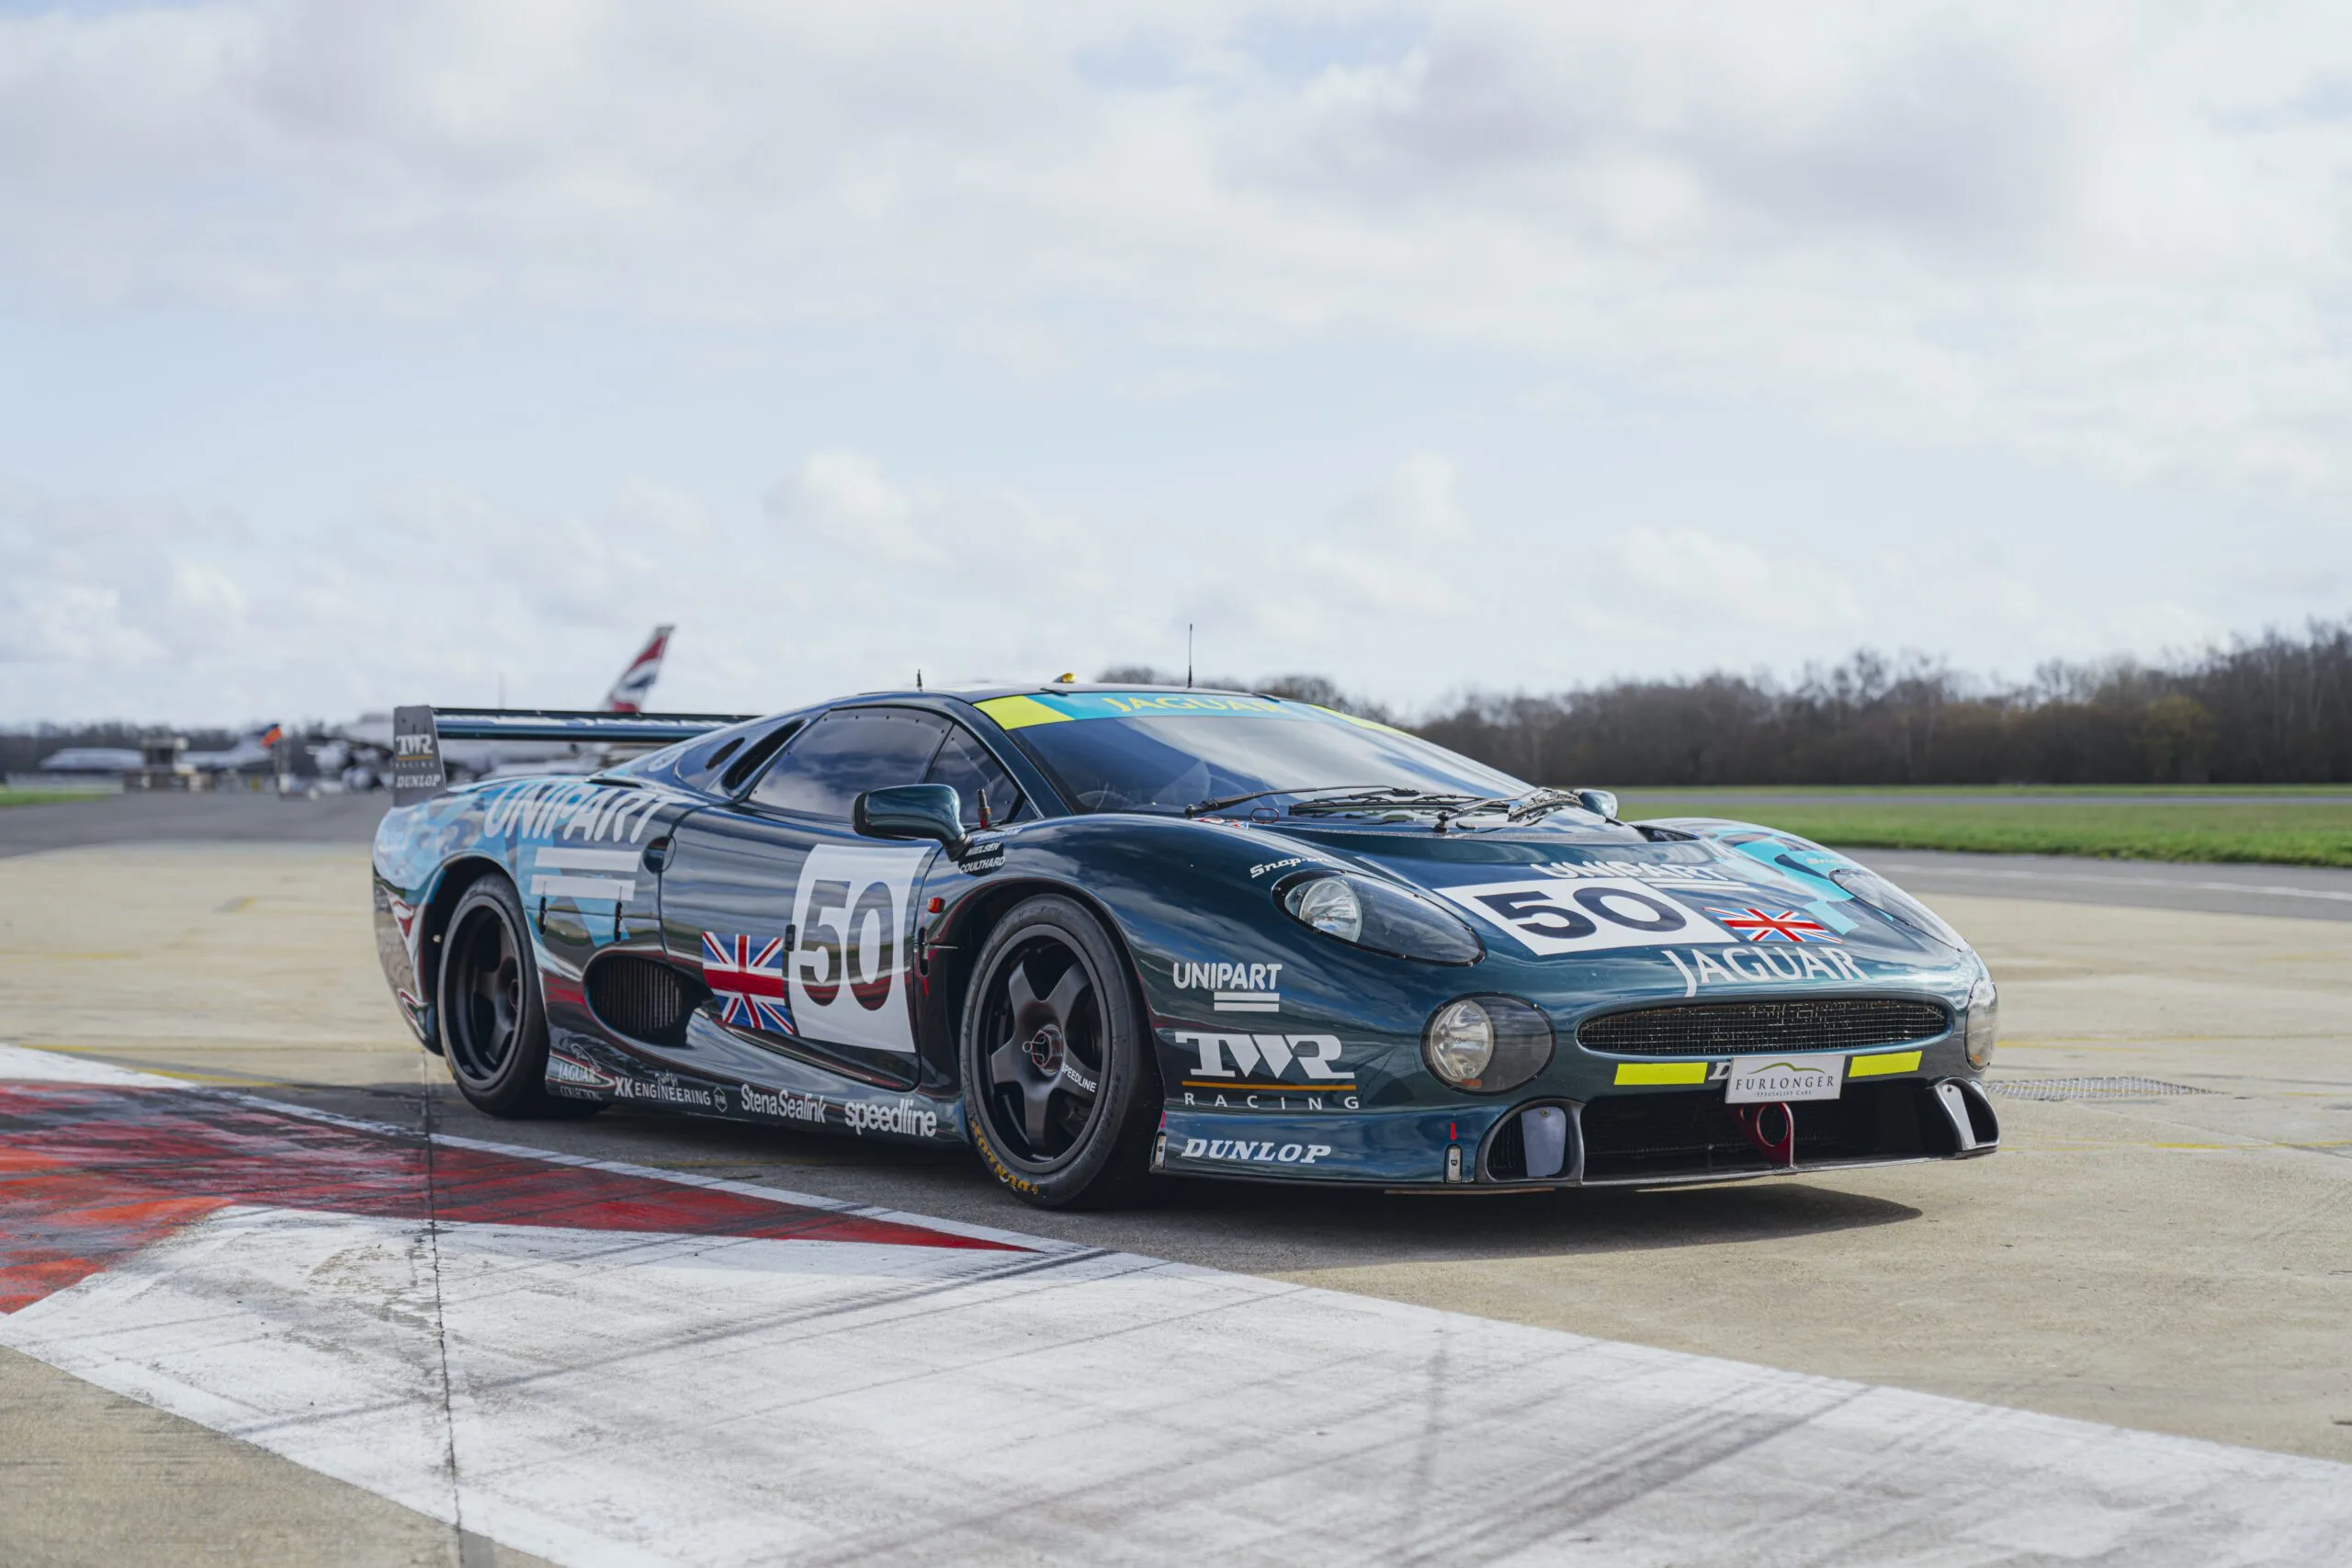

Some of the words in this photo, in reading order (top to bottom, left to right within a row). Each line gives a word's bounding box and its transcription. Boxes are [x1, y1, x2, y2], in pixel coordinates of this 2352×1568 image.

[1102, 697, 1290, 714] JAGUAR
[396, 734, 434, 755] TWR
[396, 774, 441, 788] DUNLOP
[483, 782, 673, 844] UNIPART
[958, 856, 1005, 874] COULTHARD
[1531, 861, 1725, 881] UNIPART
[1473, 886, 1688, 940] 50
[798, 879, 894, 1012] 50
[1172, 963, 1283, 990] UNIPART
[1661, 946, 1869, 998] JAGUAR
[1174, 1032, 1356, 1079] TWR
[559, 1063, 600, 1084] JAGUAR
[1061, 1062, 1097, 1093] SPEEDLINE
[1736, 1076, 1834, 1091] FURLONGER
[614, 1076, 634, 1099] XK
[635, 1082, 711, 1106] ENGINEERING
[1184, 1092, 1360, 1111] RACING
[844, 1099, 937, 1137] speedline
[1182, 1139, 1331, 1164] DUNLOP
